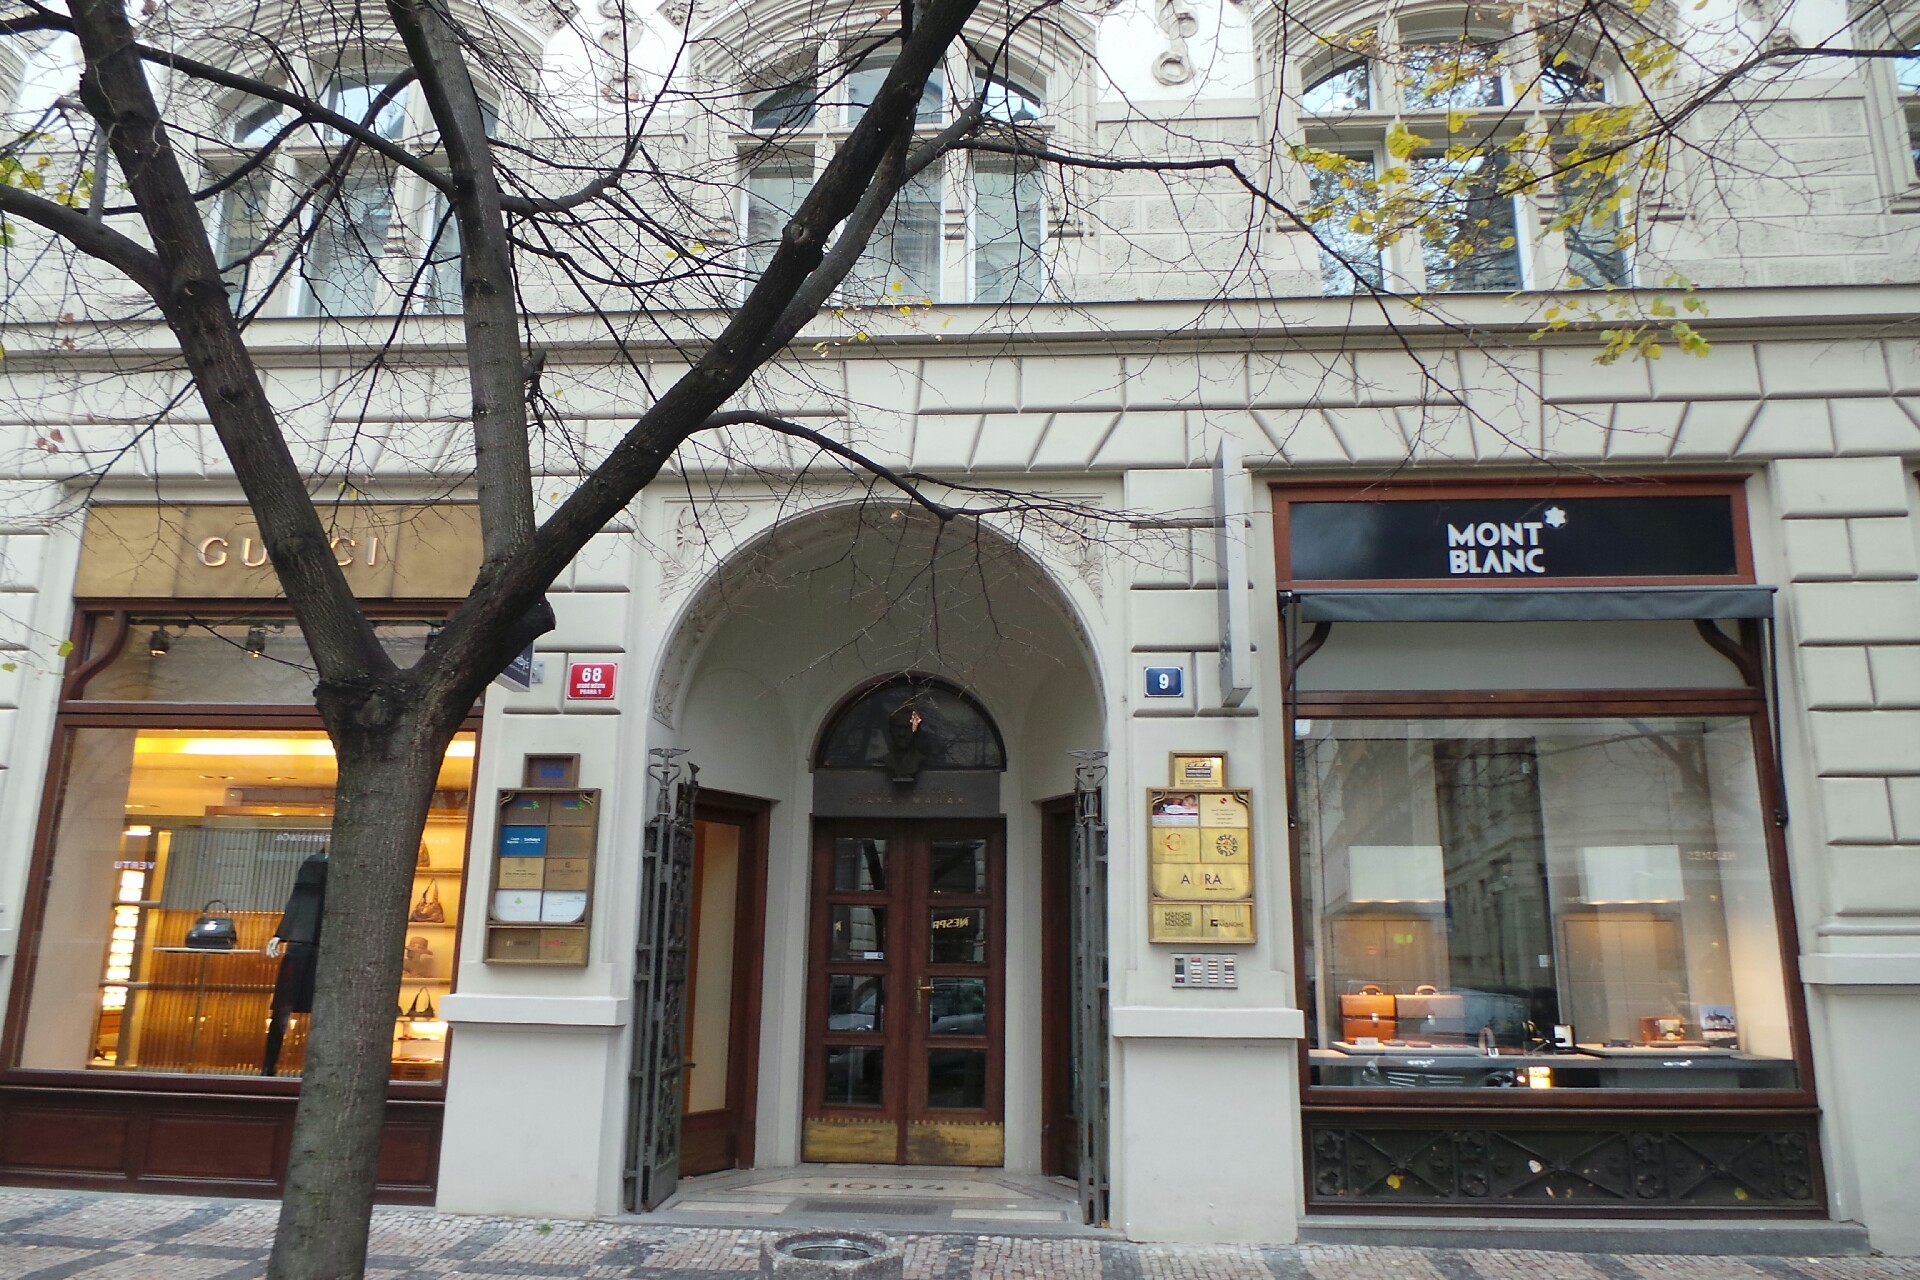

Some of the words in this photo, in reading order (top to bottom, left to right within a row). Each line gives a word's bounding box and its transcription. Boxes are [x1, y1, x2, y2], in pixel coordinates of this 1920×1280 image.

[1447, 522, 1543, 547] MONT
[198, 536, 378, 567] GUCI
[1449, 548, 1545, 574] BLANC
[581, 667, 602, 683] 68
[1158, 673, 1169, 690] 9
[1181, 873, 1222, 886] AURA
